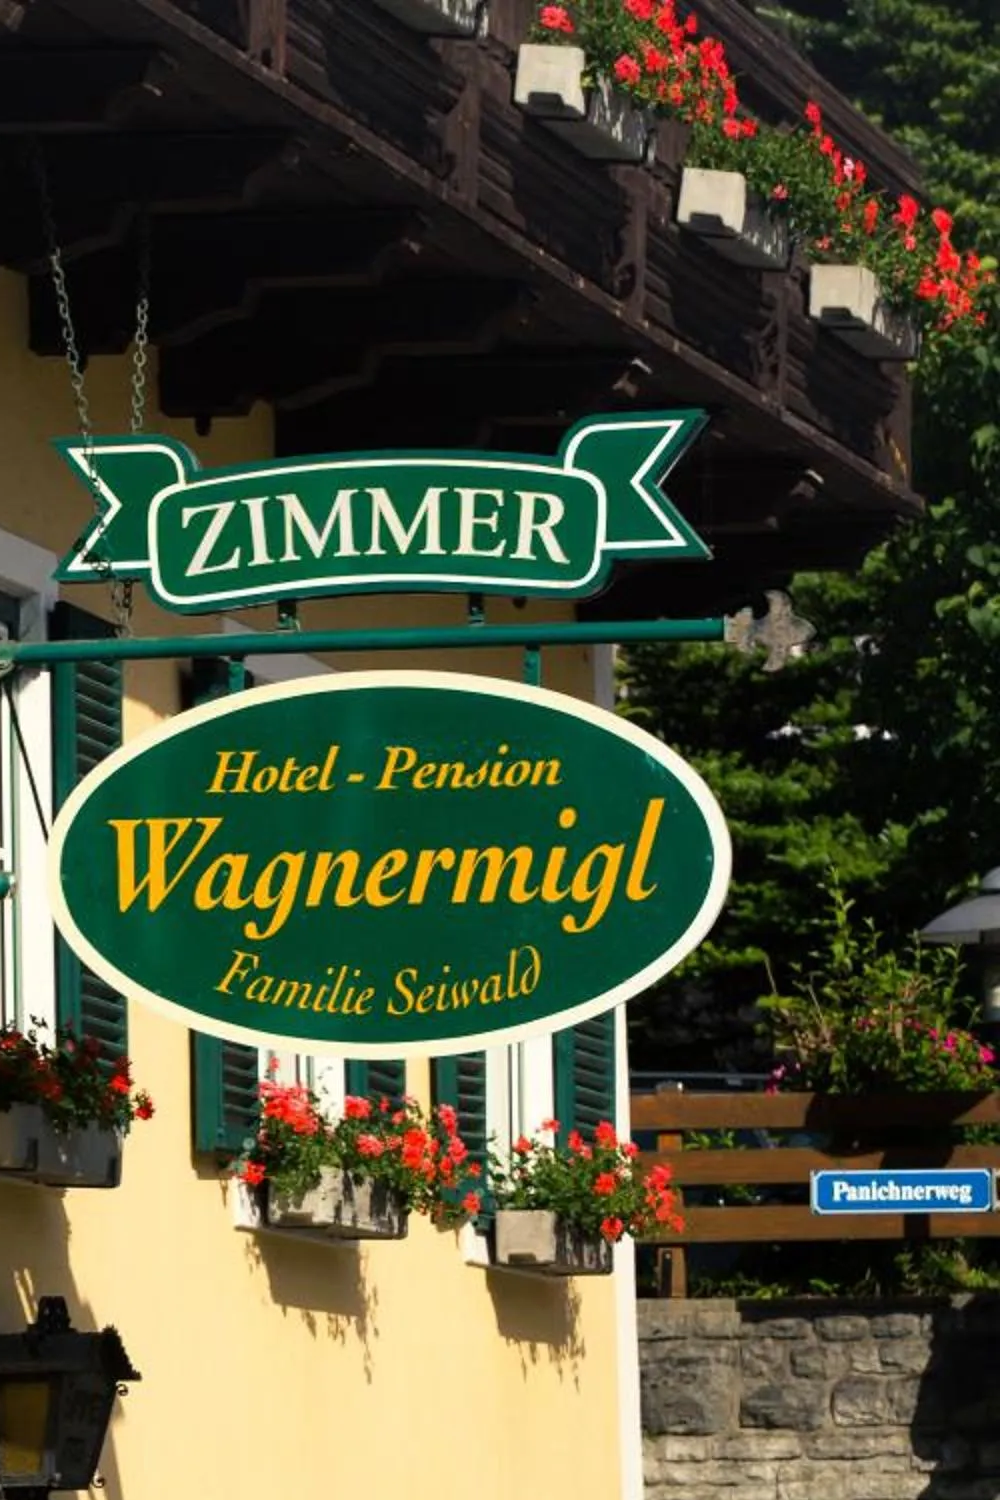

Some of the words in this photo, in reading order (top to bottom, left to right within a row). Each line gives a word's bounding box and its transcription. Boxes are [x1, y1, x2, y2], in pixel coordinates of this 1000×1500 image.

[182, 487, 569, 578] ZIMMER
[205, 745, 337, 793] Hotel
[374, 744, 562, 791] Pension
[107, 798, 664, 941] Wagnermigl
[215, 949, 375, 1017] Familie
[387, 945, 542, 1016] Seiwald
[832, 1180, 973, 1204] Panichnerweg
